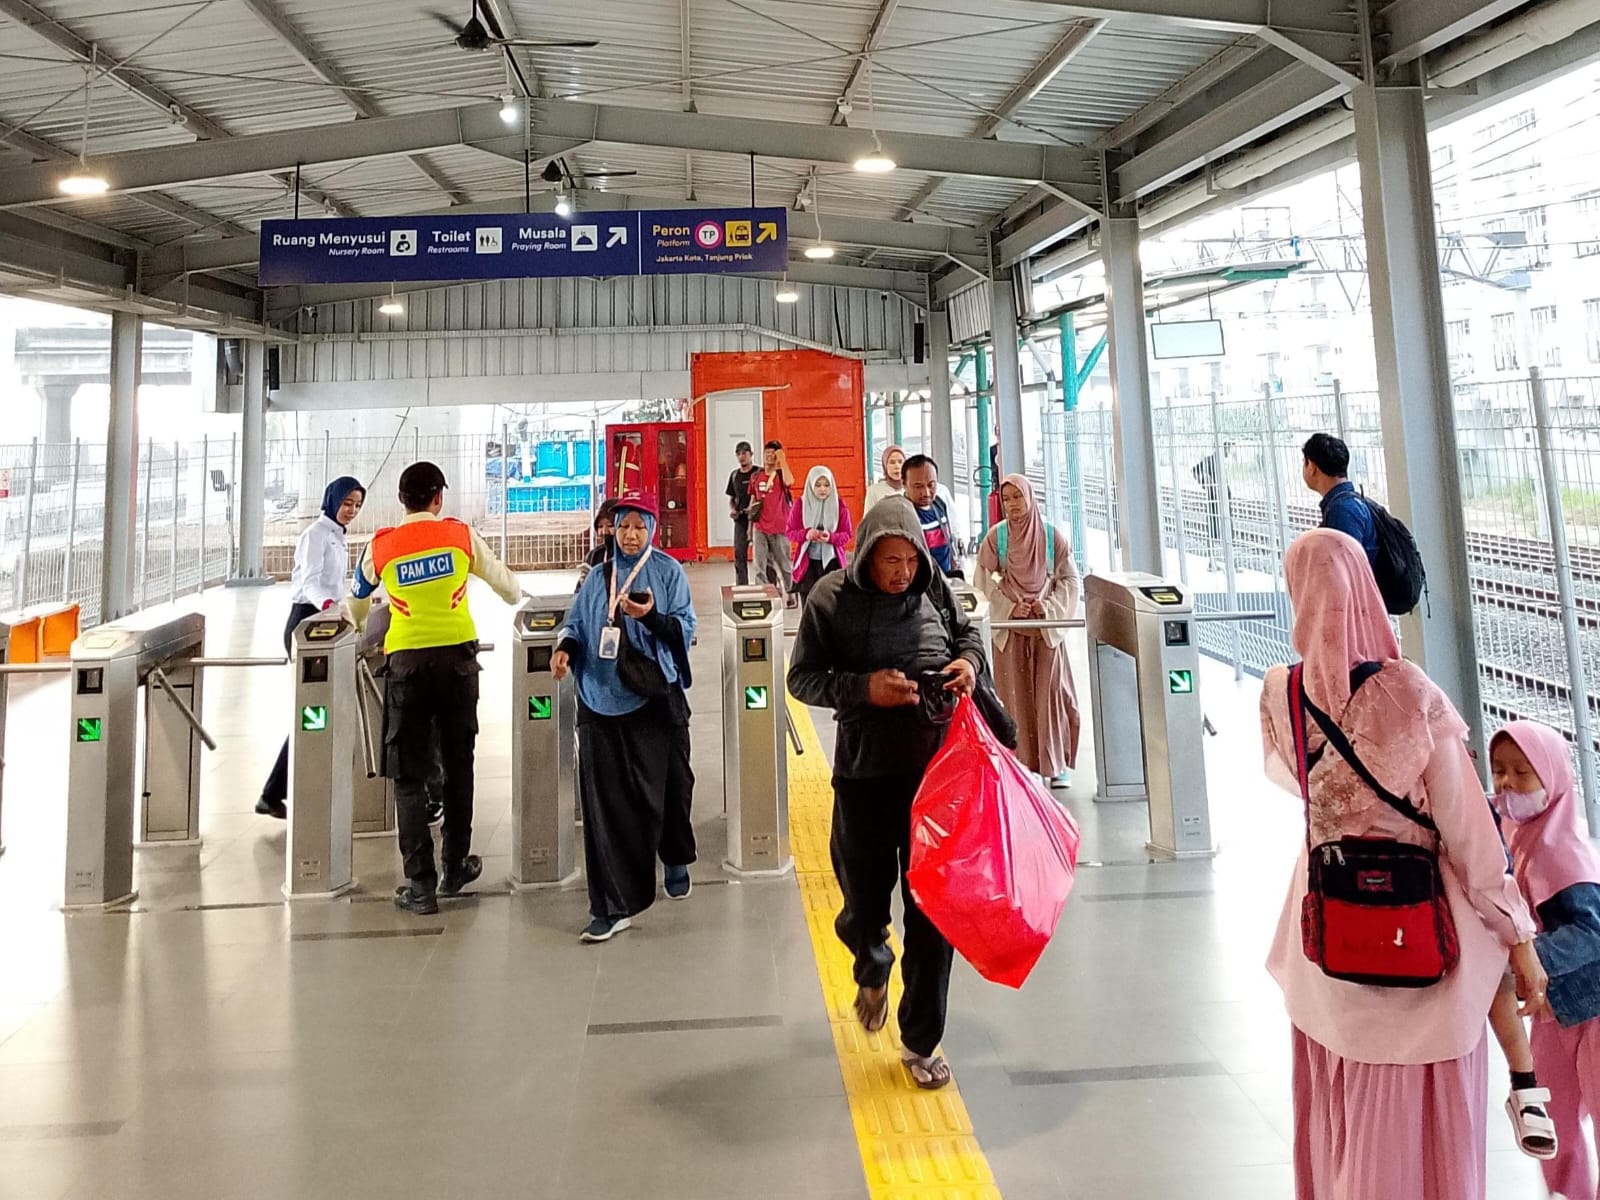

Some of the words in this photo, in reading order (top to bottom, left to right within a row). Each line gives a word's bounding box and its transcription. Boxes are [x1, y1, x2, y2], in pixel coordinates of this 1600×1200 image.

[519, 226, 566, 240] Musala
[652, 224, 690, 236] Peron
[702, 230, 716, 239] TP
[273, 234, 316, 247] Ruang
[319, 231, 386, 246] Menyusui
[432, 230, 471, 243] Toilet
[511, 243, 541, 252] Praying
[544, 242, 567, 250] Room
[656, 239, 691, 248] Platform
[328, 247, 360, 257] Nursery
[361, 246, 385, 255] Room
[427, 245, 470, 254] Restrooms
[705, 254, 733, 262] Tanjung
[401, 563, 424, 580] PAM
[429, 557, 449, 574] KCI
